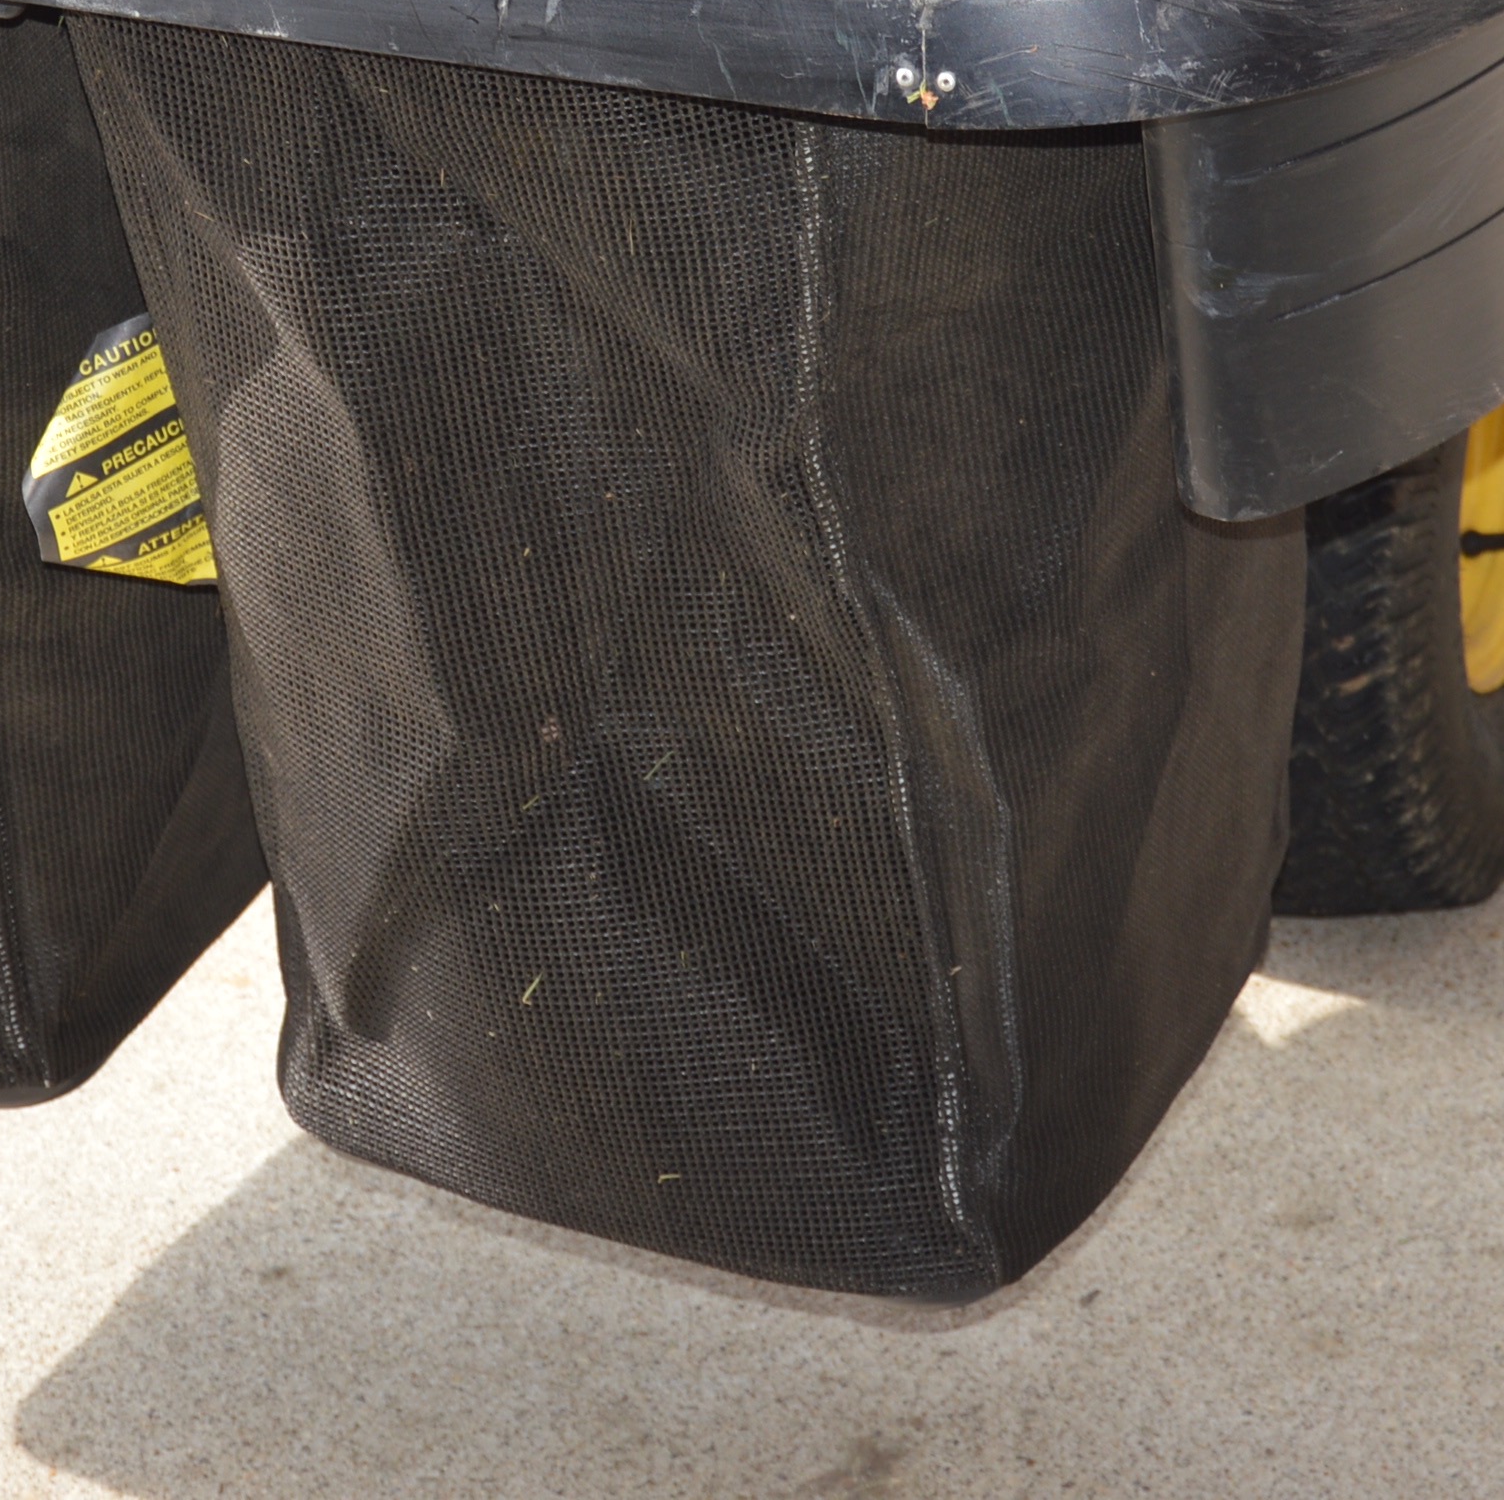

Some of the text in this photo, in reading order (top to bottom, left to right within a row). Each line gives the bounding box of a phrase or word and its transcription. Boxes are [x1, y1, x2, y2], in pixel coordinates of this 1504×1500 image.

[62, 351, 157, 404] UBJECT TO WEAR AND
[65, 411, 84, 423] BAG
[144, 368, 165, 384] REPL
[59, 426, 101, 449] ORIGINAL
[103, 414, 122, 428] BAG
[123, 406, 134, 417] TO
[135, 386, 169, 409] COMPLY
[101, 418, 184, 475] PRECAUCI
[63, 507, 74, 517] LA
[75, 491, 102, 510] BOLSA
[123, 462, 153, 482] SUJETA
[159, 442, 187, 462] DESGA
[68, 510, 105, 533] REVISAR
[106, 504, 117, 514] LA
[118, 488, 146, 507] BOLSA
[97, 516, 130, 537] BOLSAS
[131, 496, 167, 521] ORIGINAL
[168, 483, 188, 499] PARA
[138, 514, 205, 556] ATTENT
